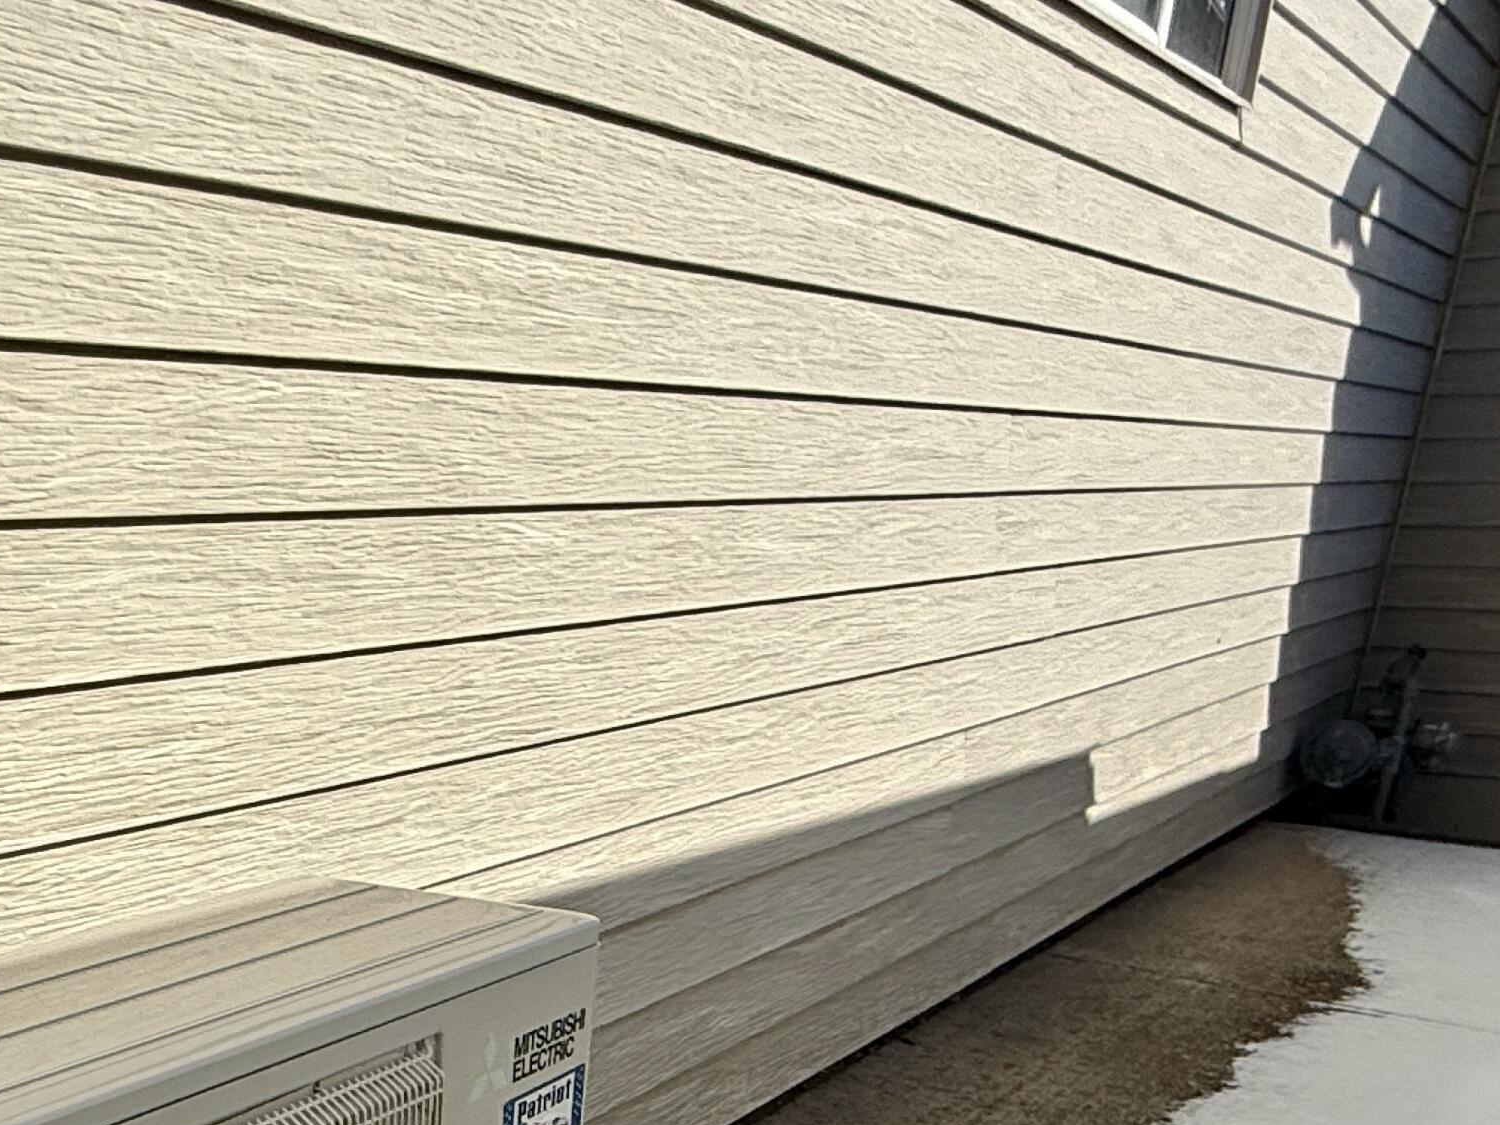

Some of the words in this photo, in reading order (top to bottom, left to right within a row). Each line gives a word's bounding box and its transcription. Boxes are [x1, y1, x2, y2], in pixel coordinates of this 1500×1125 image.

[514, 1007, 586, 1058] MITSUBISHI
[512, 1036, 575, 1083] ELECTRIC
[517, 1080, 572, 1123] Patriot
